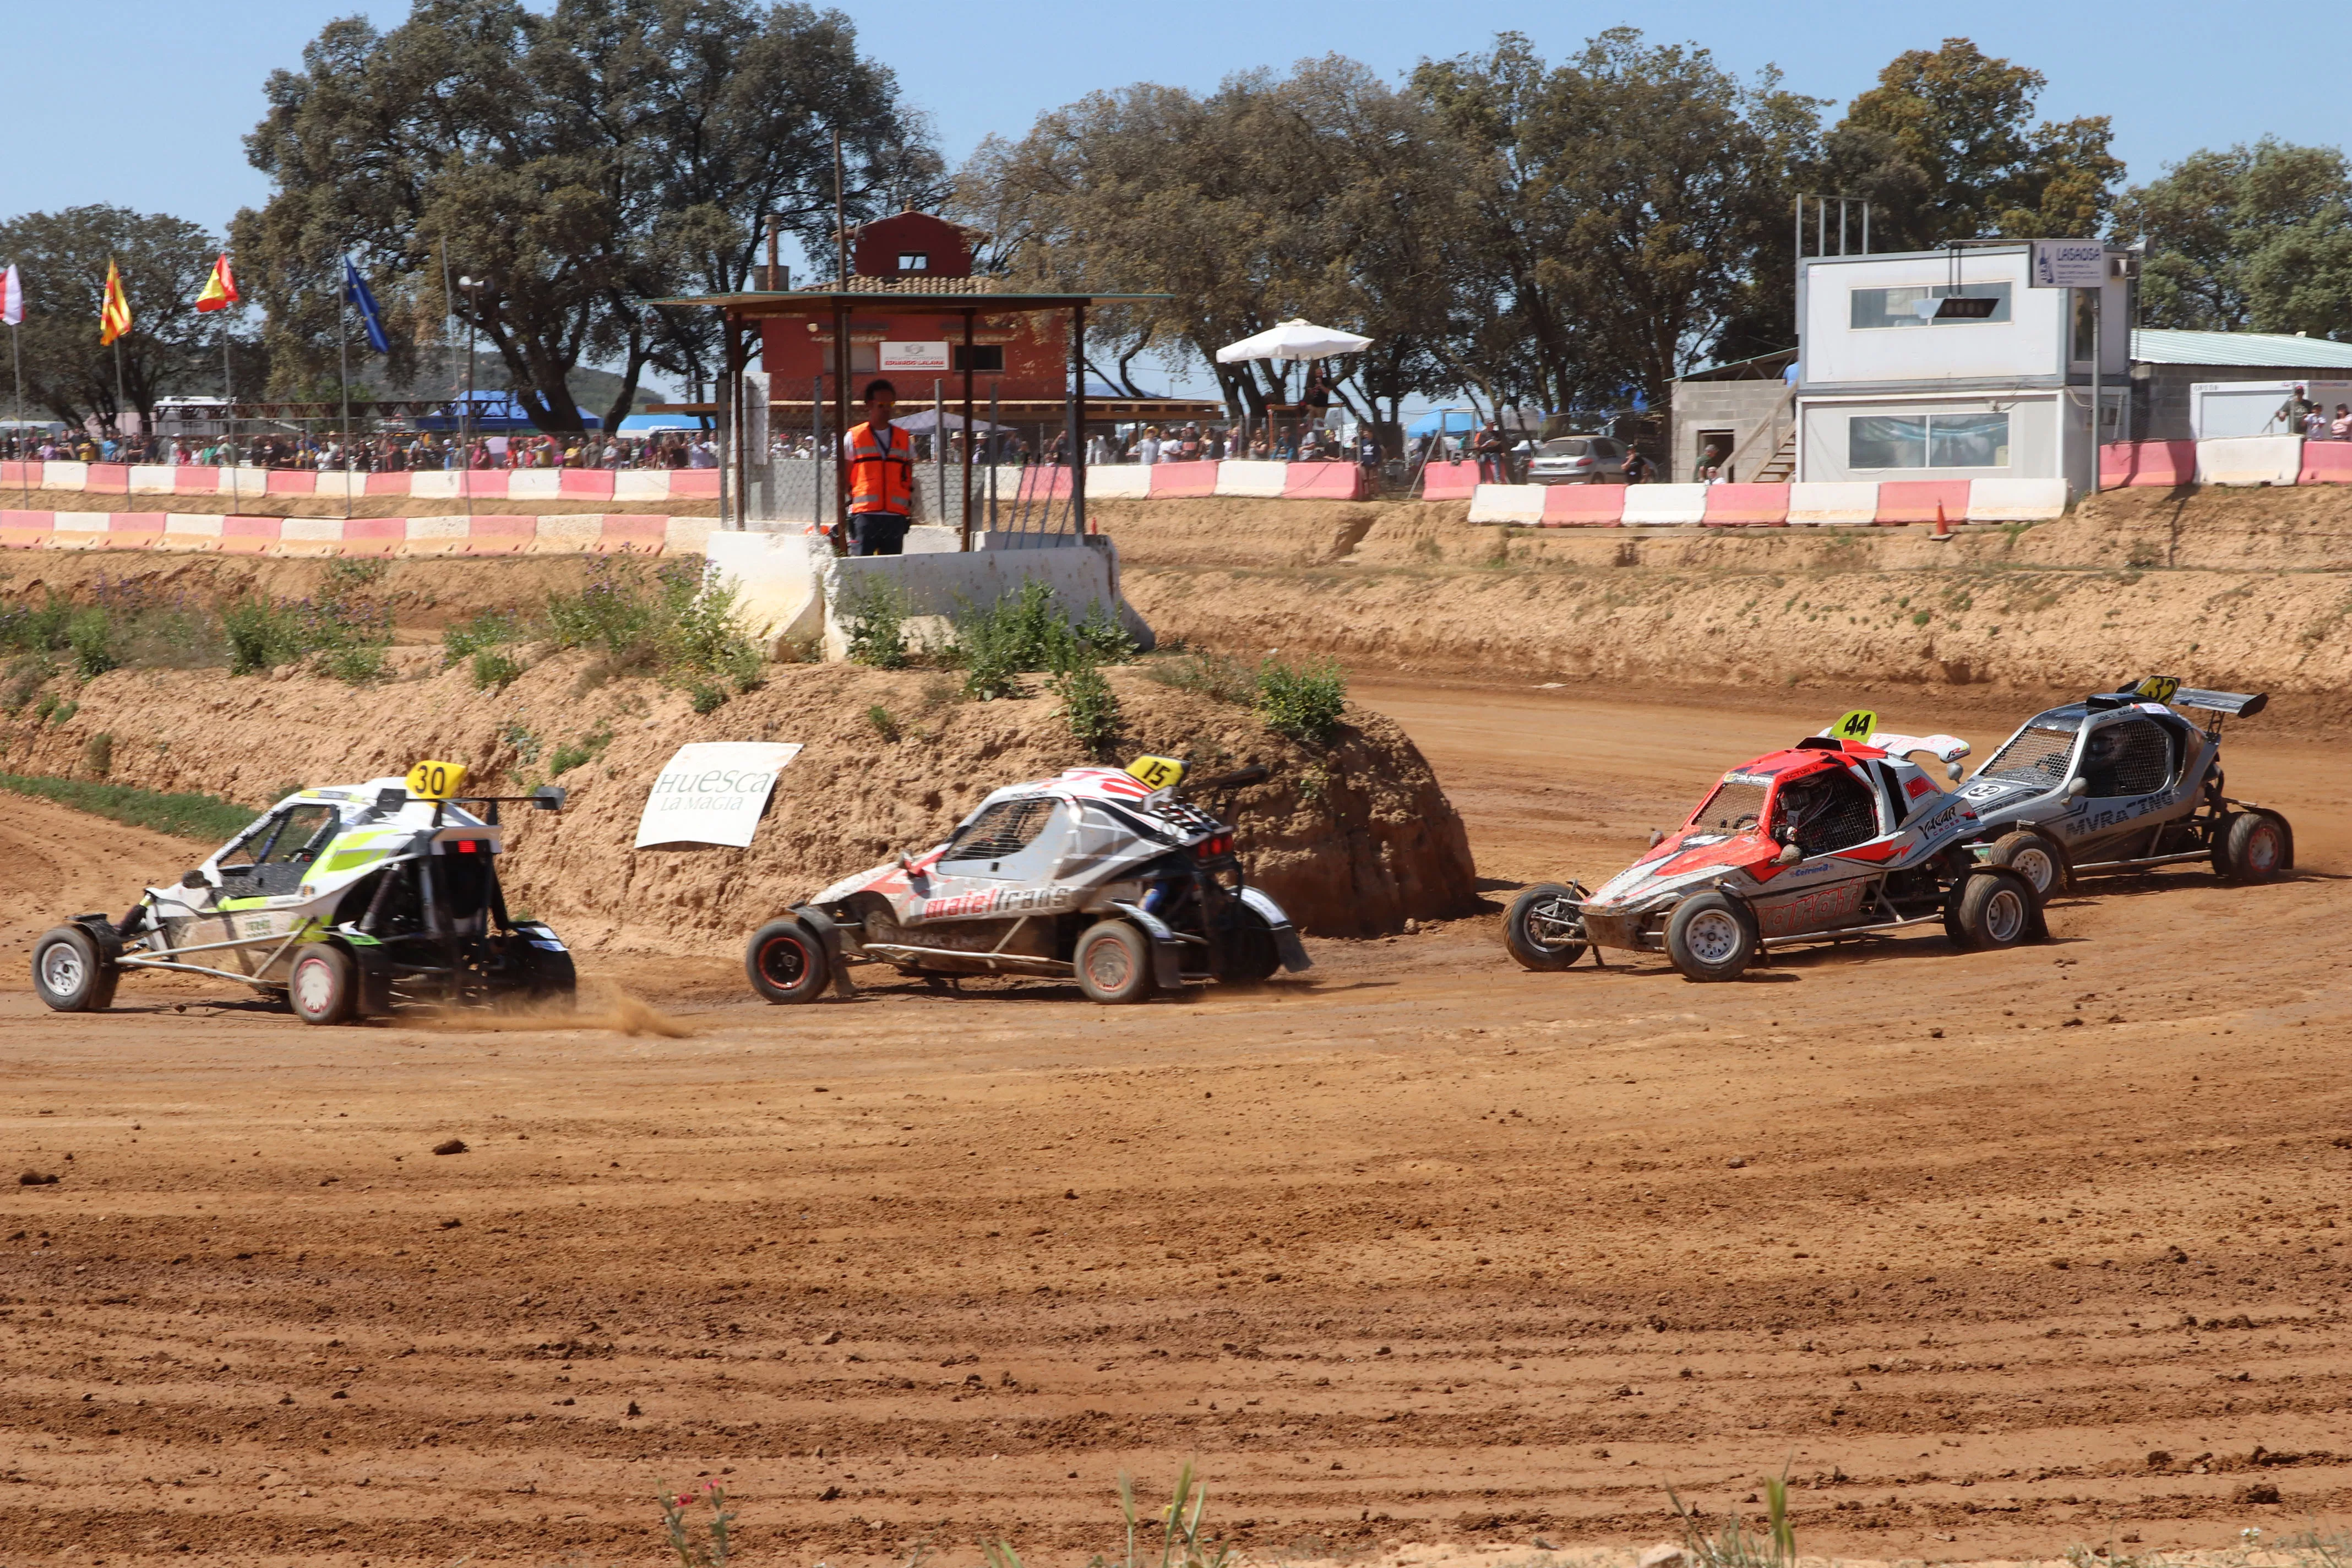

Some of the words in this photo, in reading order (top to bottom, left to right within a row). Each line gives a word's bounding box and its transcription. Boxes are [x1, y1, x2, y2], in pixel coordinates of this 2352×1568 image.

[2057, 247, 2100, 260] LASAOSA
[2148, 677, 2179, 705] 32
[1843, 713, 1872, 736] 44
[415, 765, 446, 796] 30
[654, 770, 771, 793] Huesca
[1142, 760, 1172, 787] 15
[1970, 785, 2000, 797] 32
[1983, 803, 2002, 815] PRO
[1918, 805, 1957, 840] YACAR
